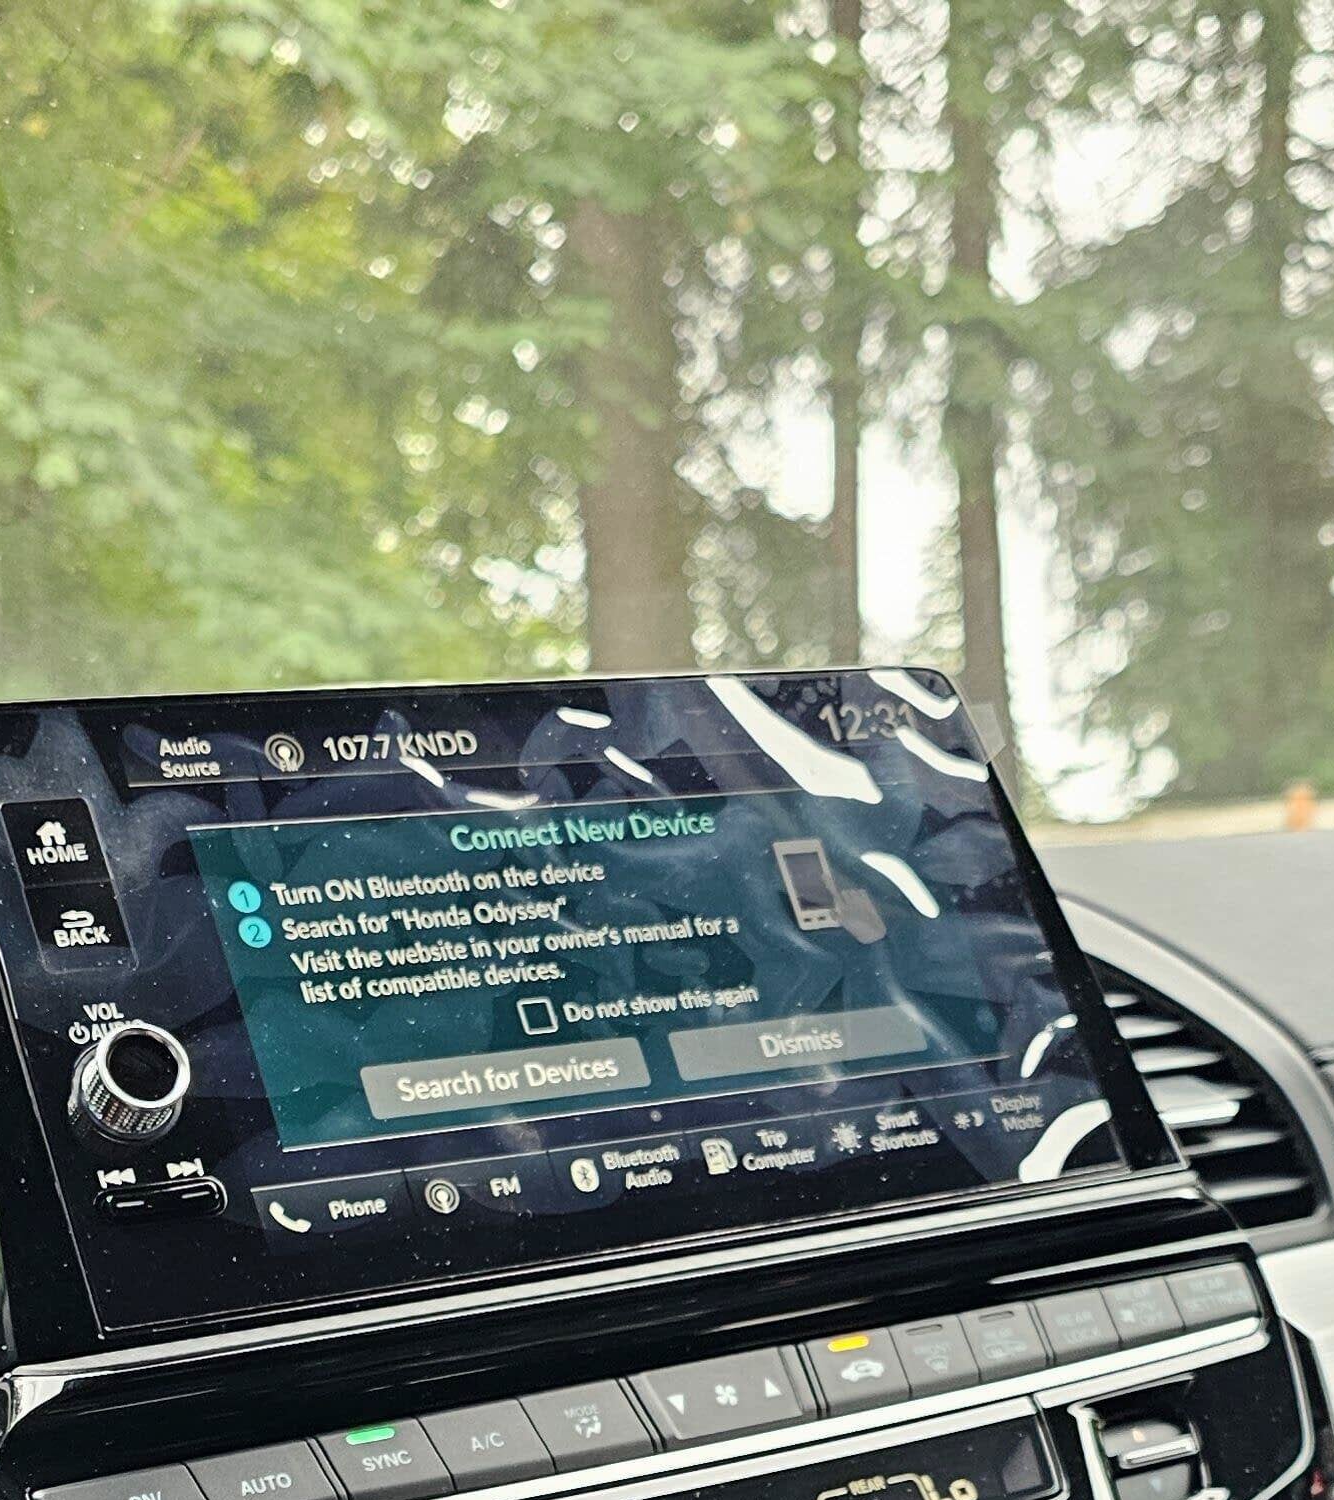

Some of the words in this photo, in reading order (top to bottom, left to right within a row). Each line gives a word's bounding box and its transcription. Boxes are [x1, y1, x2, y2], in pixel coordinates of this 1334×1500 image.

[159, 737, 212, 757] Audio
[323, 734, 392, 762] 107.7
[396, 729, 479, 759] KNDD
[160, 760, 221, 780] Source
[450, 819, 565, 851] Connect
[564, 816, 625, 845] New
[628, 808, 717, 840] Device
[26, 843, 89, 865] HOME
[270, 882, 323, 906] Turn
[324, 878, 365, 902] ON
[367, 871, 470, 900] Bluetooth
[473, 871, 501, 891] on
[503, 865, 538, 888] the
[541, 861, 605, 886] device
[282, 914, 356, 940] Search
[357, 911, 390, 935] for
[392, 905, 471, 931] "Honda
[473, 895, 566, 925] Odyssey"
[53, 926, 110, 948] BACK
[291, 949, 344, 975] Visit
[345, 945, 384, 970] the
[385, 939, 468, 966] website
[469, 935, 492, 958] in
[493, 933, 540, 960] your
[544, 925, 621, 951] owner's
[623, 919, 692, 945] manual
[693, 916, 723, 937] for
[725, 916, 740, 935] a
[300, 980, 337, 1004] list
[338, 975, 363, 1000] of
[367, 968, 481, 998] compatible
[484, 961, 566, 988] devices.
[83, 1002, 124, 1022] VOL
[562, 1001, 595, 1023] Do
[596, 998, 629, 1020] not
[631, 993, 678, 1016] show
[678, 989, 712, 1011] this
[714, 985, 759, 1008] again
[758, 1029, 844, 1058] Dismiss
[396, 1071, 482, 1103] Search
[484, 1066, 521, 1093] for
[523, 1057, 619, 1087] Devices
[990, 1094, 1042, 1115] Display
[875, 1110, 919, 1131] Smart
[1001, 1113, 1045, 1132] Mode
[756, 1129, 788, 1149] Trip
[869, 1128, 939, 1152] Shortcuts
[601, 1144, 681, 1171] Bluetooth
[742, 1147, 816, 1171] Computer
[489, 1175, 521, 1197] FM
[625, 1168, 673, 1190] Audio
[327, 1194, 388, 1220] Phone
[564, 1402, 599, 1419] MODE
[470, 1432, 506, 1453] A/C
[361, 1450, 413, 1473] SYNC
[240, 1472, 292, 1497] AUTO
[848, 1475, 887, 1495] REAR
